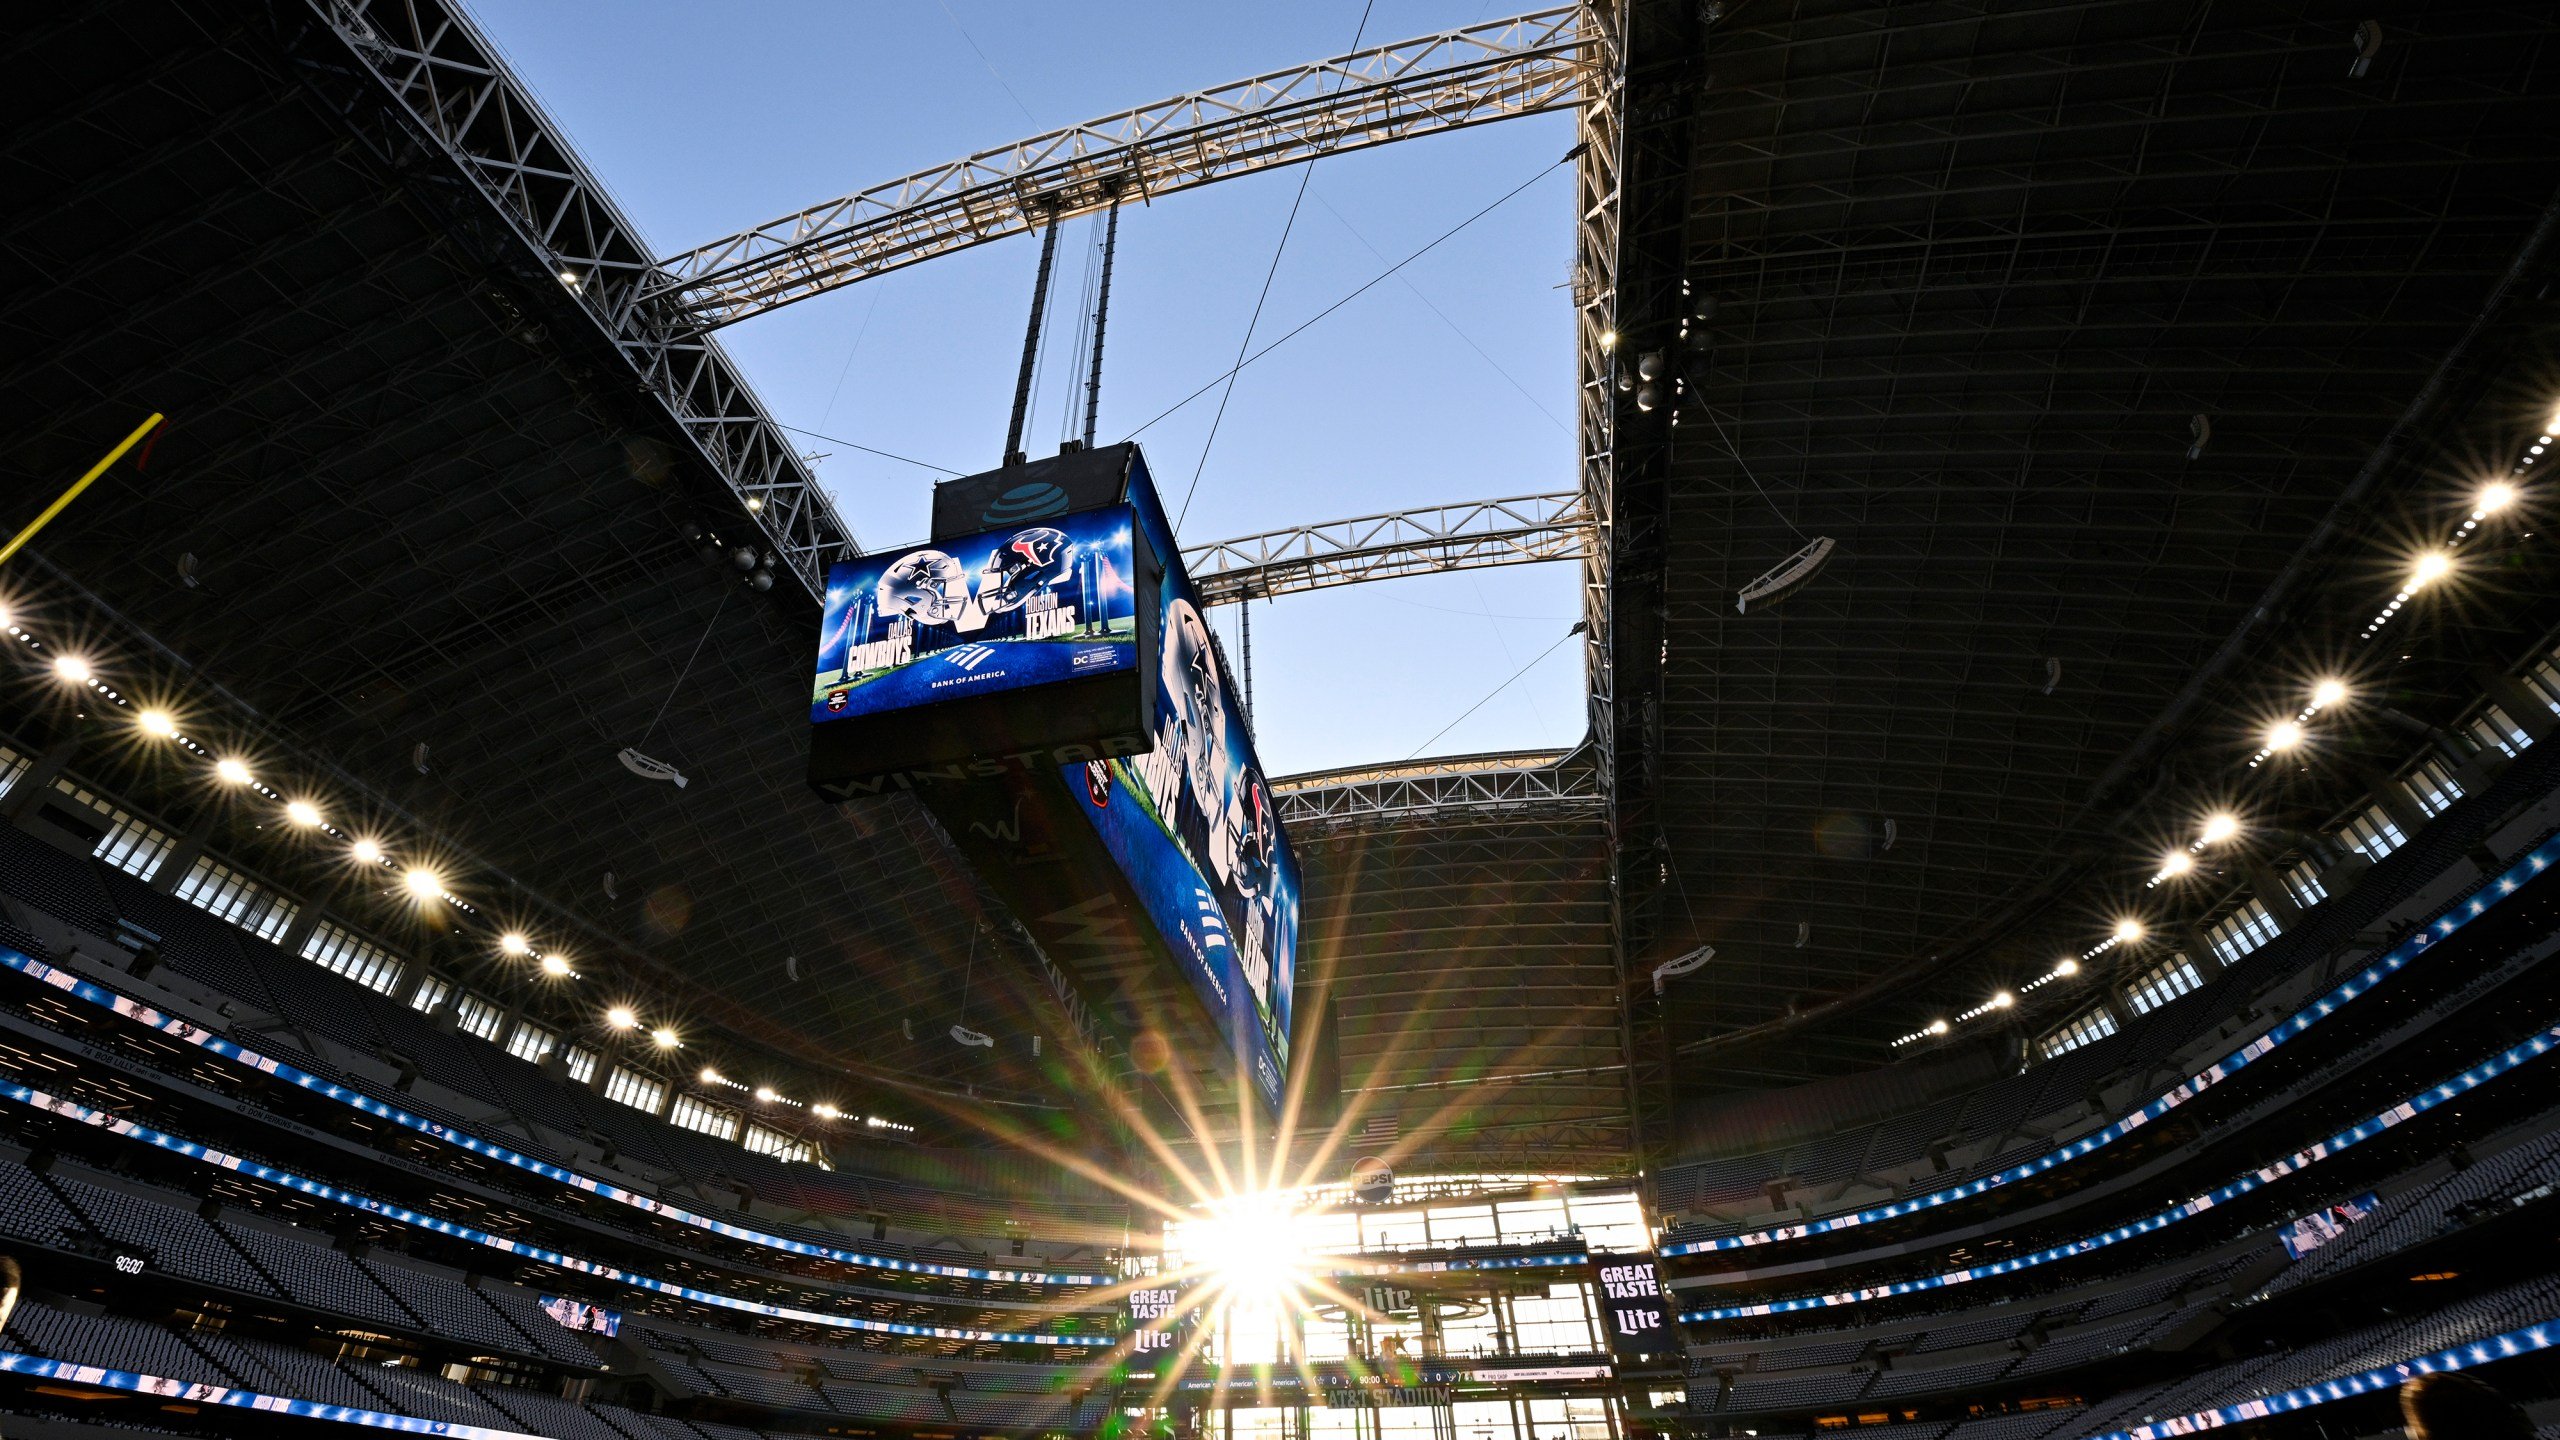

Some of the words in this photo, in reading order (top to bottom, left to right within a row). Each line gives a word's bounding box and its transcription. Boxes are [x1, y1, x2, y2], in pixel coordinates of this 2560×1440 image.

[1026, 591, 1059, 614] HOUSTON
[888, 620, 913, 639] DALLAS
[1025, 605, 1076, 640] TEXANS
[848, 635, 912, 672] COWBOYS
[1073, 656, 1088, 665] DC
[931, 679, 954, 689] BANK
[967, 670, 1006, 682] AMERICA
[1180, 919, 1197, 953] BANK
[1204, 962, 1227, 1006] AMERICA
[80, 1046, 92, 1056] 74
[94, 1051, 113, 1064] BOB
[112, 1059, 135, 1072] LILLY
[1352, 1174, 1392, 1185] PEPSI
[1600, 1263, 1654, 1283] GREAT
[1129, 1289, 1177, 1304] GREAT
[1604, 1280, 1659, 1299] TASTE
[1131, 1304, 1176, 1319] TASTE
[1614, 1309, 1661, 1335] Lite
[1133, 1329, 1172, 1353] Lite
[1359, 1375, 1380, 1384] 90:00
[1328, 1388, 1369, 1408] AT&T
[1372, 1386, 1451, 1407] STADIUM
